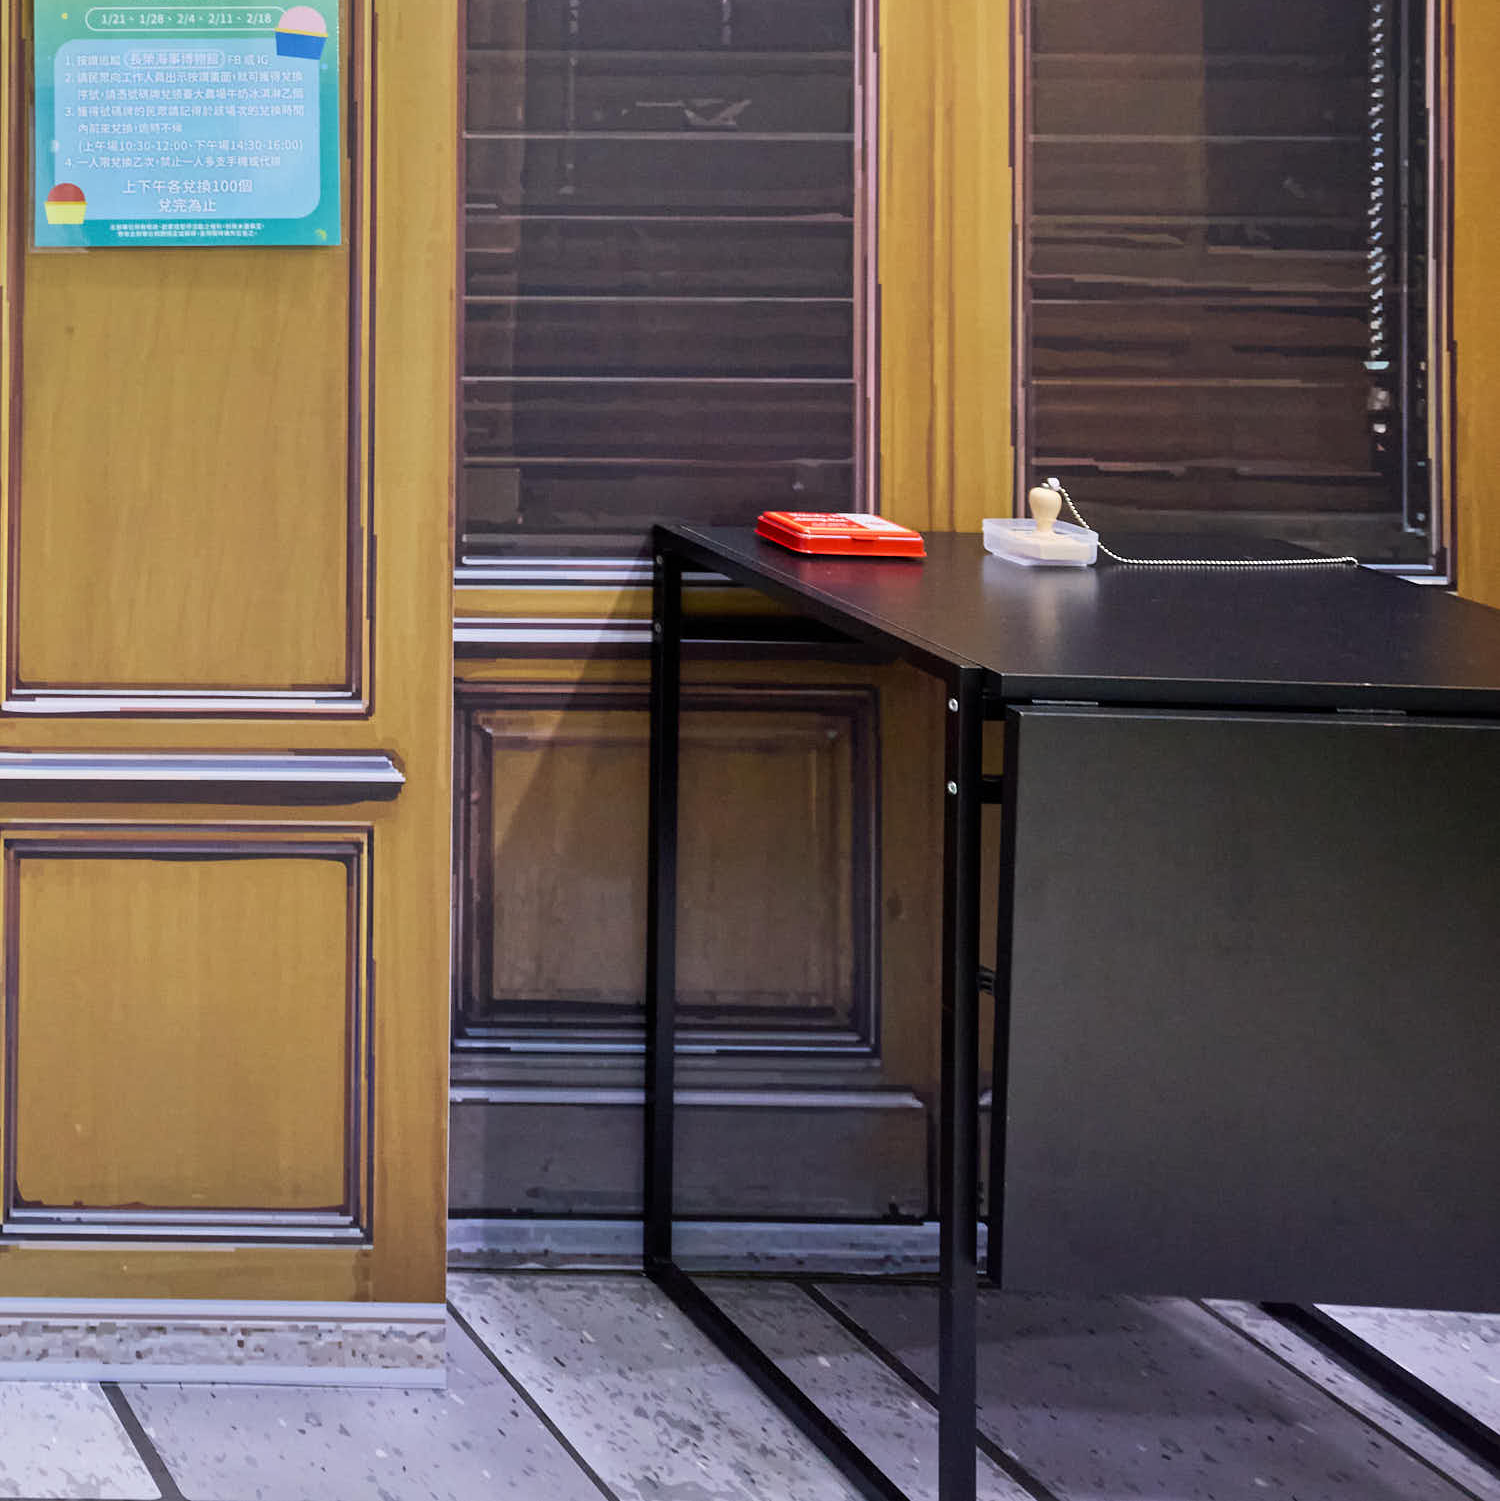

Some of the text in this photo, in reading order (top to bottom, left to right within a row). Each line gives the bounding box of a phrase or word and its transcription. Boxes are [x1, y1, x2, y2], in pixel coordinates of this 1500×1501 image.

[122, 179, 253, 195] 上下午各兌換100個
[158, 198, 217, 213] 兌完為止
